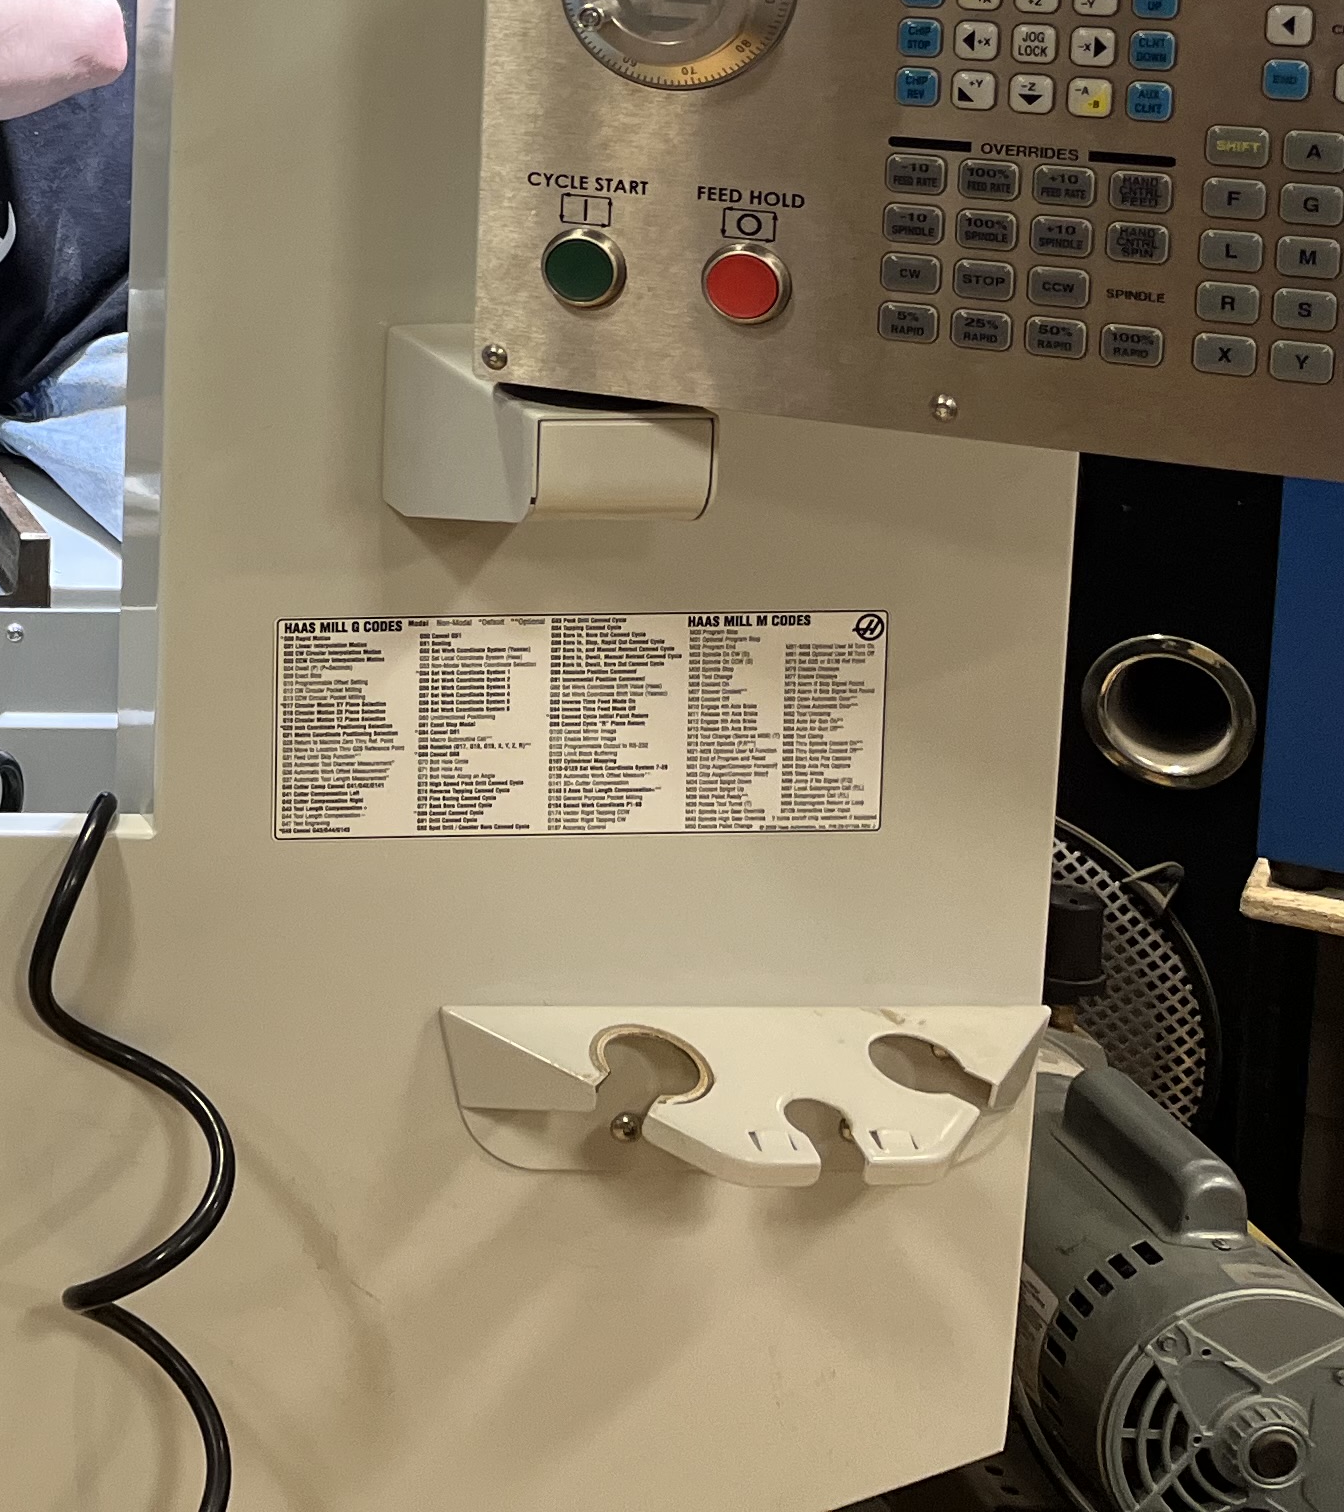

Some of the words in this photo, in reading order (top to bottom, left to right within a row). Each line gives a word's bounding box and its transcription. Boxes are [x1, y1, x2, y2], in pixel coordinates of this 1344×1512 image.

[1021, 32, 1045, 43] JOG
[1018, 45, 1048, 57] LOCK
[981, 142, 1079, 161] OVERRIDES
[1216, 140, 1261, 153] SHIFT
[1306, 144, 1322, 160] A
[527, 172, 589, 190] CYCLE
[595, 177, 649, 195] START
[697, 186, 743, 204] FEED
[749, 190, 805, 209] HOLD
[1227, 191, 1241, 206] F
[1303, 197, 1319, 213] G
[1225, 244, 1238, 259] L
[1299, 249, 1317, 265] M
[899, 268, 921, 279] CW
[962, 274, 1005, 287] STOP
[1106, 288, 1166, 304] SPINDLE
[1221, 295, 1235, 311] R
[1298, 302, 1312, 318] S
[1218, 347, 1232, 363] X
[1295, 354, 1309, 370] Y
[284, 621, 316, 634] HAAS
[320, 621, 348, 634] MILL
[363, 620, 402, 633] CODES
[688, 616, 720, 628] HAAS
[724, 615, 753, 627] MILL
[757, 615, 767, 627] M
[771, 614, 811, 626] CODES
